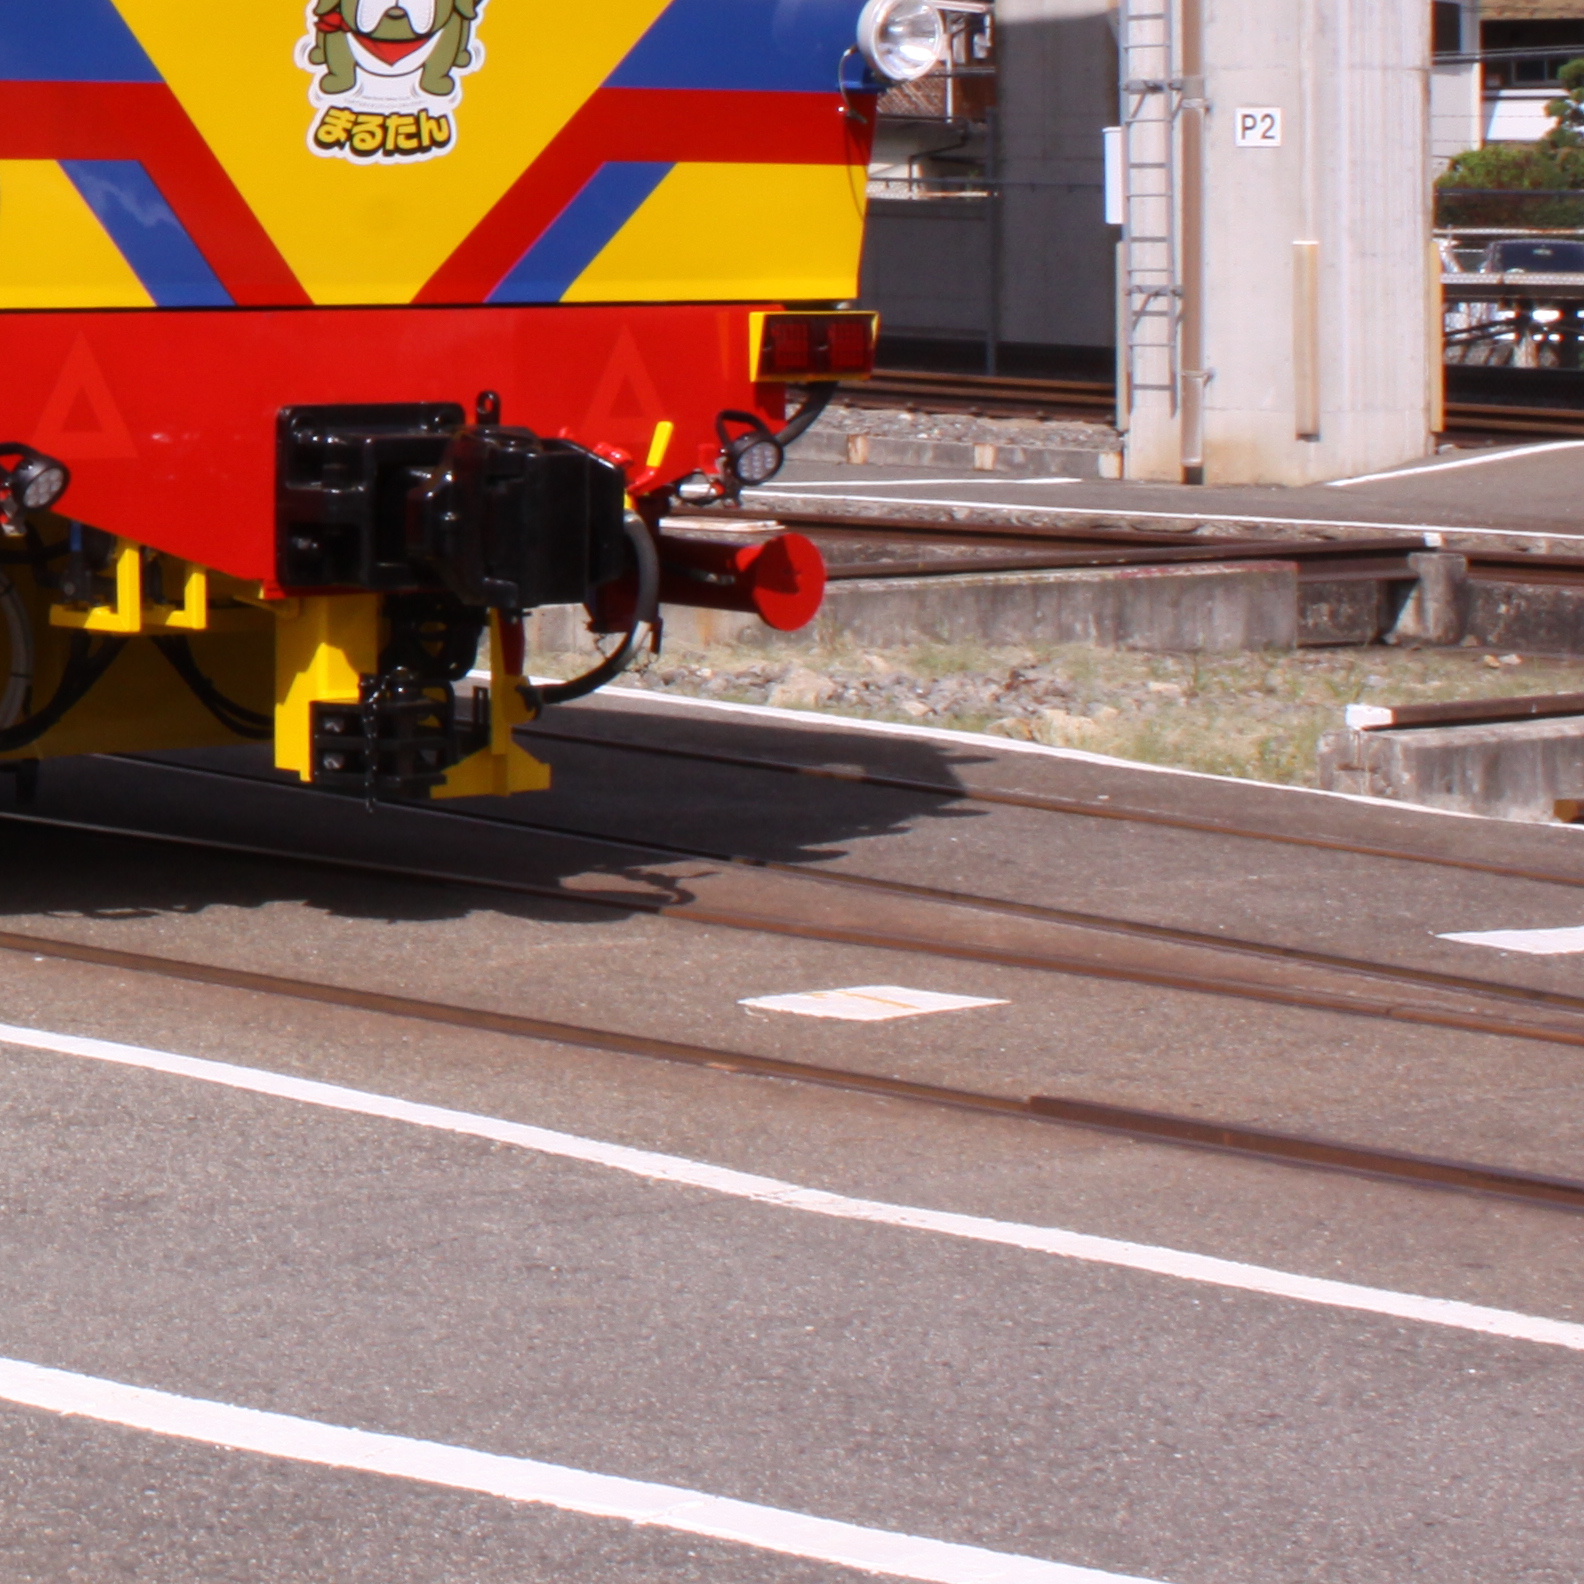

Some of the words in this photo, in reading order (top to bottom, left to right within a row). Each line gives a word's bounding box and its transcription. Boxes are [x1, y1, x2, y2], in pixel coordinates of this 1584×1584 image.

[314, 106, 451, 157] まるたん
[1241, 113, 1276, 140] P2
